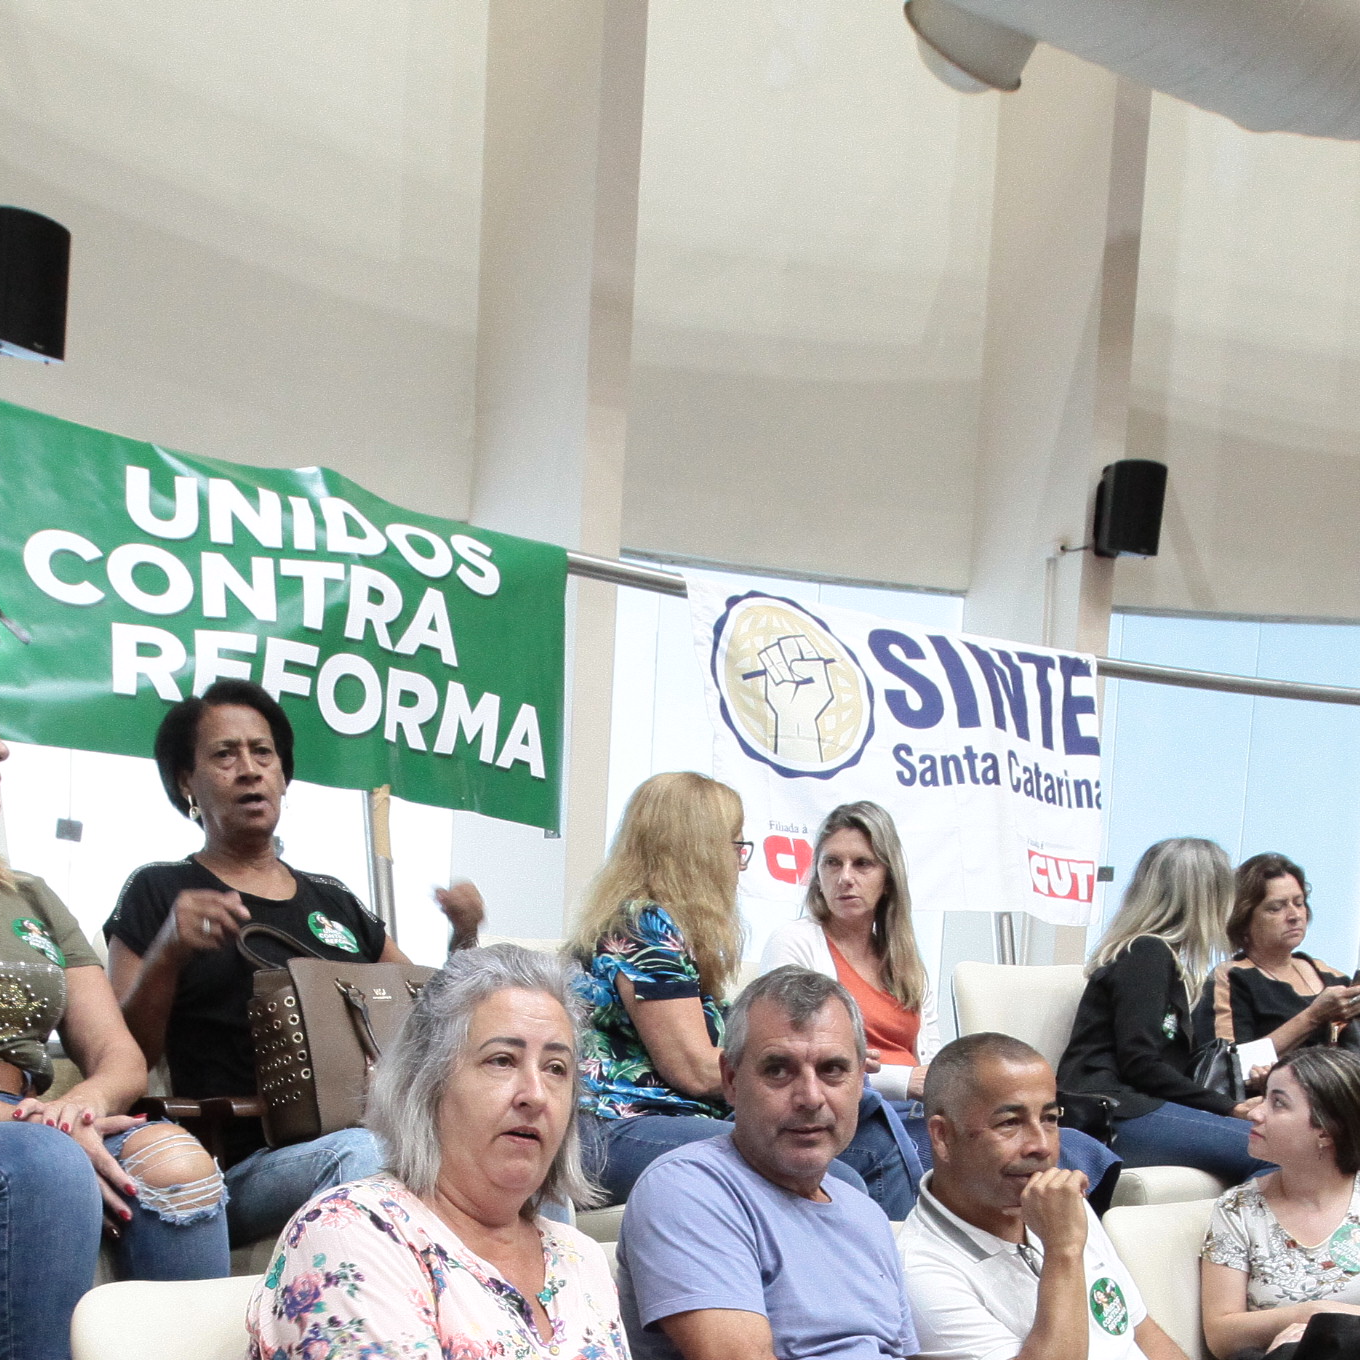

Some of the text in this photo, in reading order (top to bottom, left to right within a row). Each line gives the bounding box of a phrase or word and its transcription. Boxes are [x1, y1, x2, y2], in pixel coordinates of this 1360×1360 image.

[125, 464, 501, 597] UNIDOS
[23, 529, 459, 668] CONTRA
[111, 622, 546, 780] REFORMA
[868, 629, 1101, 757] SINTE
[892, 743, 1002, 787] Santa
[1029, 853, 1094, 901] CUT
